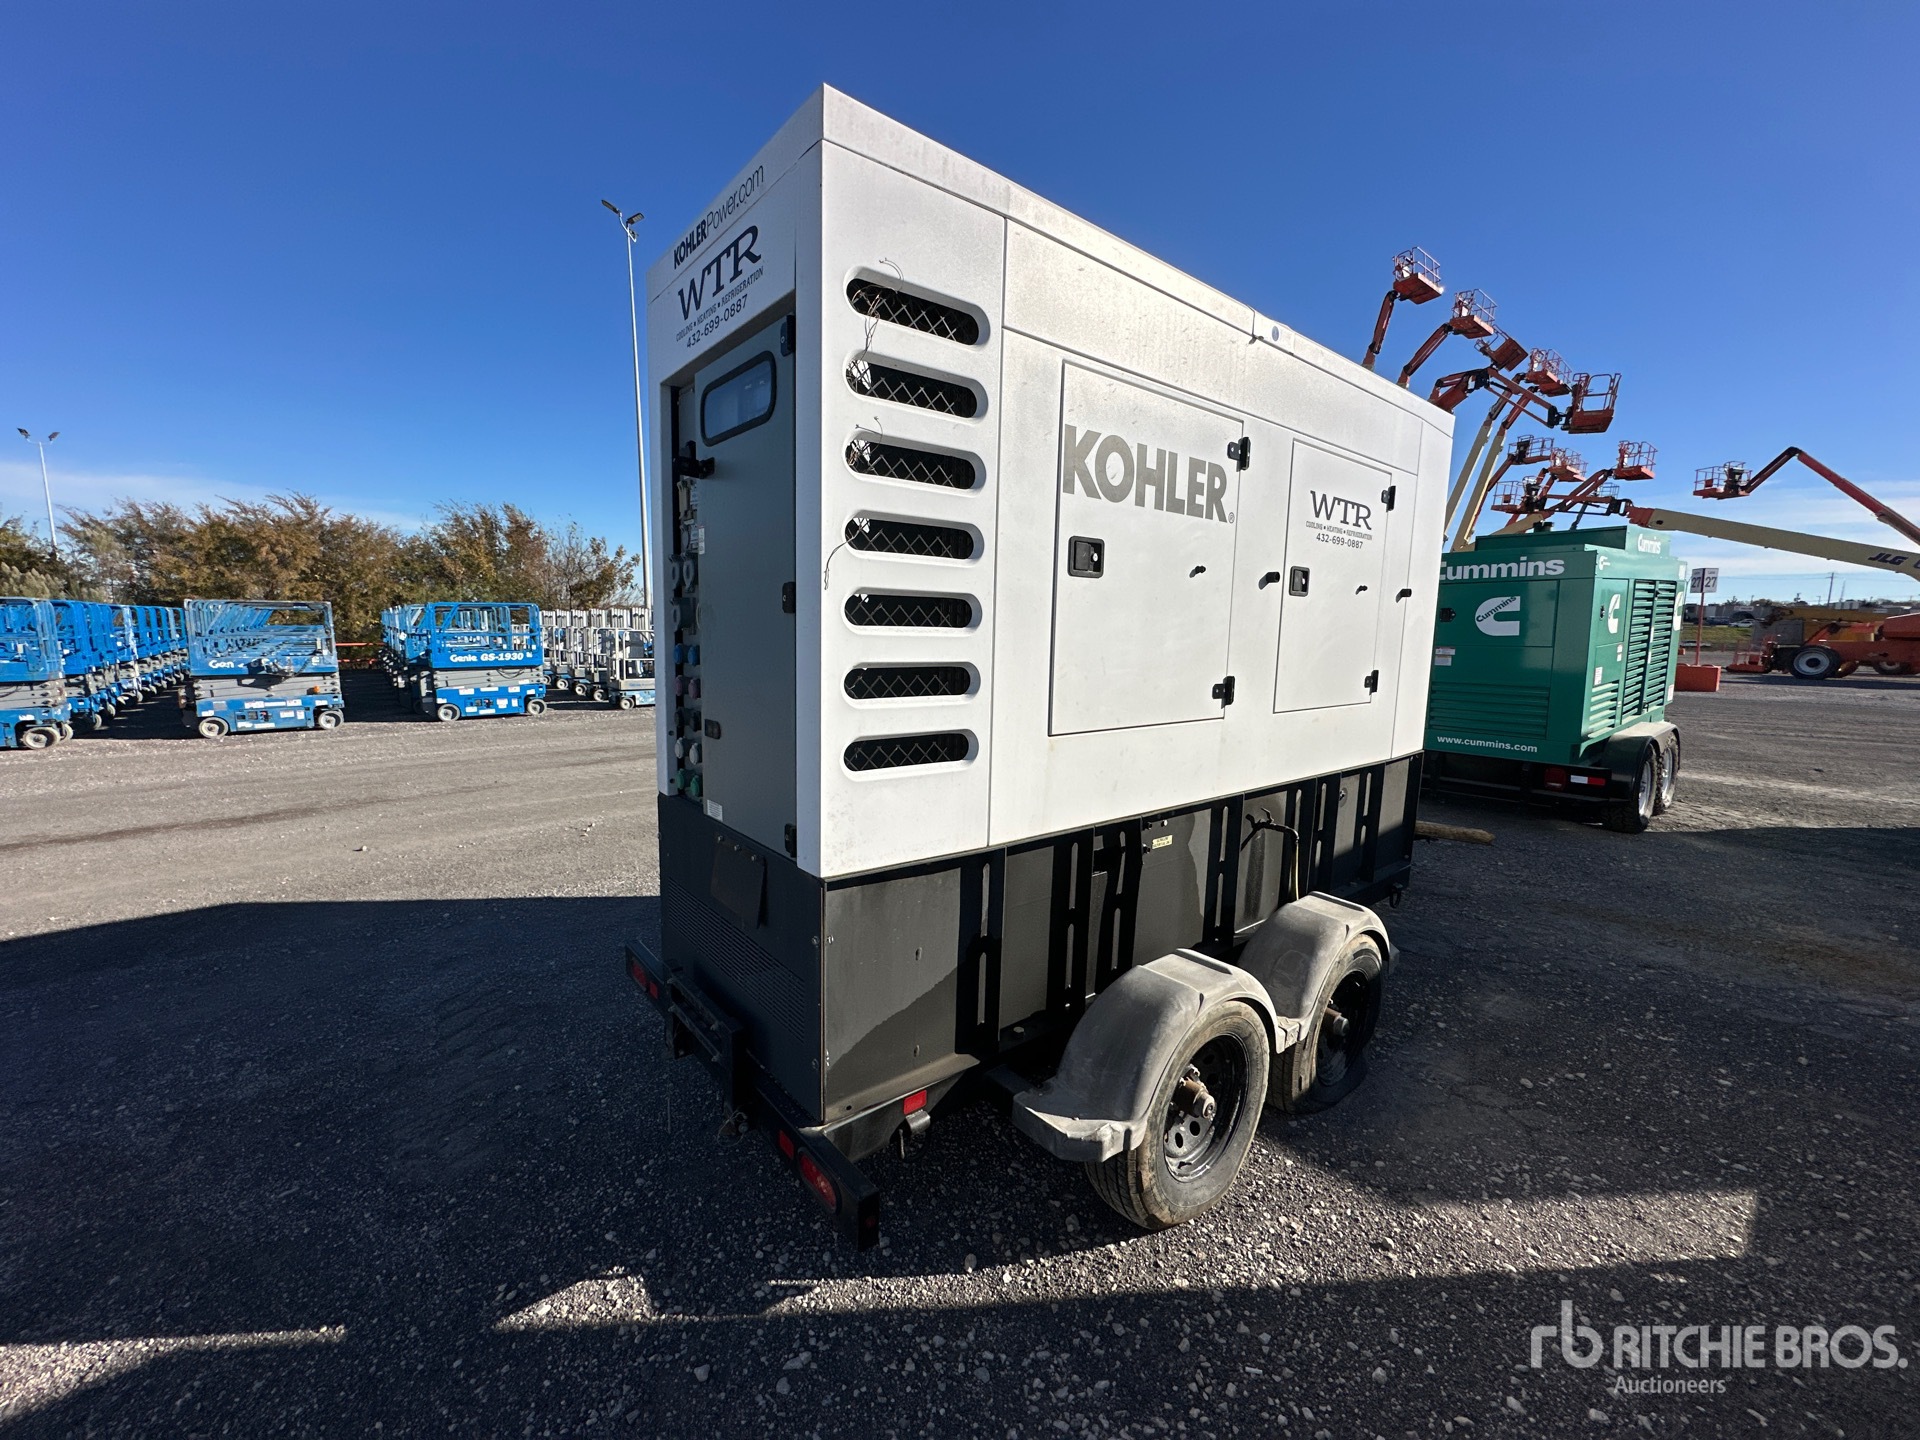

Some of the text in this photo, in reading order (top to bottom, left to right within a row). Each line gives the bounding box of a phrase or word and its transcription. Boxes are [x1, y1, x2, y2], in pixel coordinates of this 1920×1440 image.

[673, 165, 764, 270] KOHLERPower.com
[677, 225, 762, 321] WTR
[686, 293, 749, 349] 432-699-0887
[1062, 423, 1228, 523] KOHLER
[1310, 490, 1372, 531] WTR
[1316, 532, 1364, 550] 432-699-0887
[1867, 552, 1909, 566] JLG
[1690, 576, 1702, 588] 27
[1704, 576, 1718, 588] 27
[1476, 595, 1517, 623] Cummins
[449, 653, 478, 663] Genie
[480, 651, 525, 662] GS-1930
[1437, 735, 1539, 753] www.cummins.com
